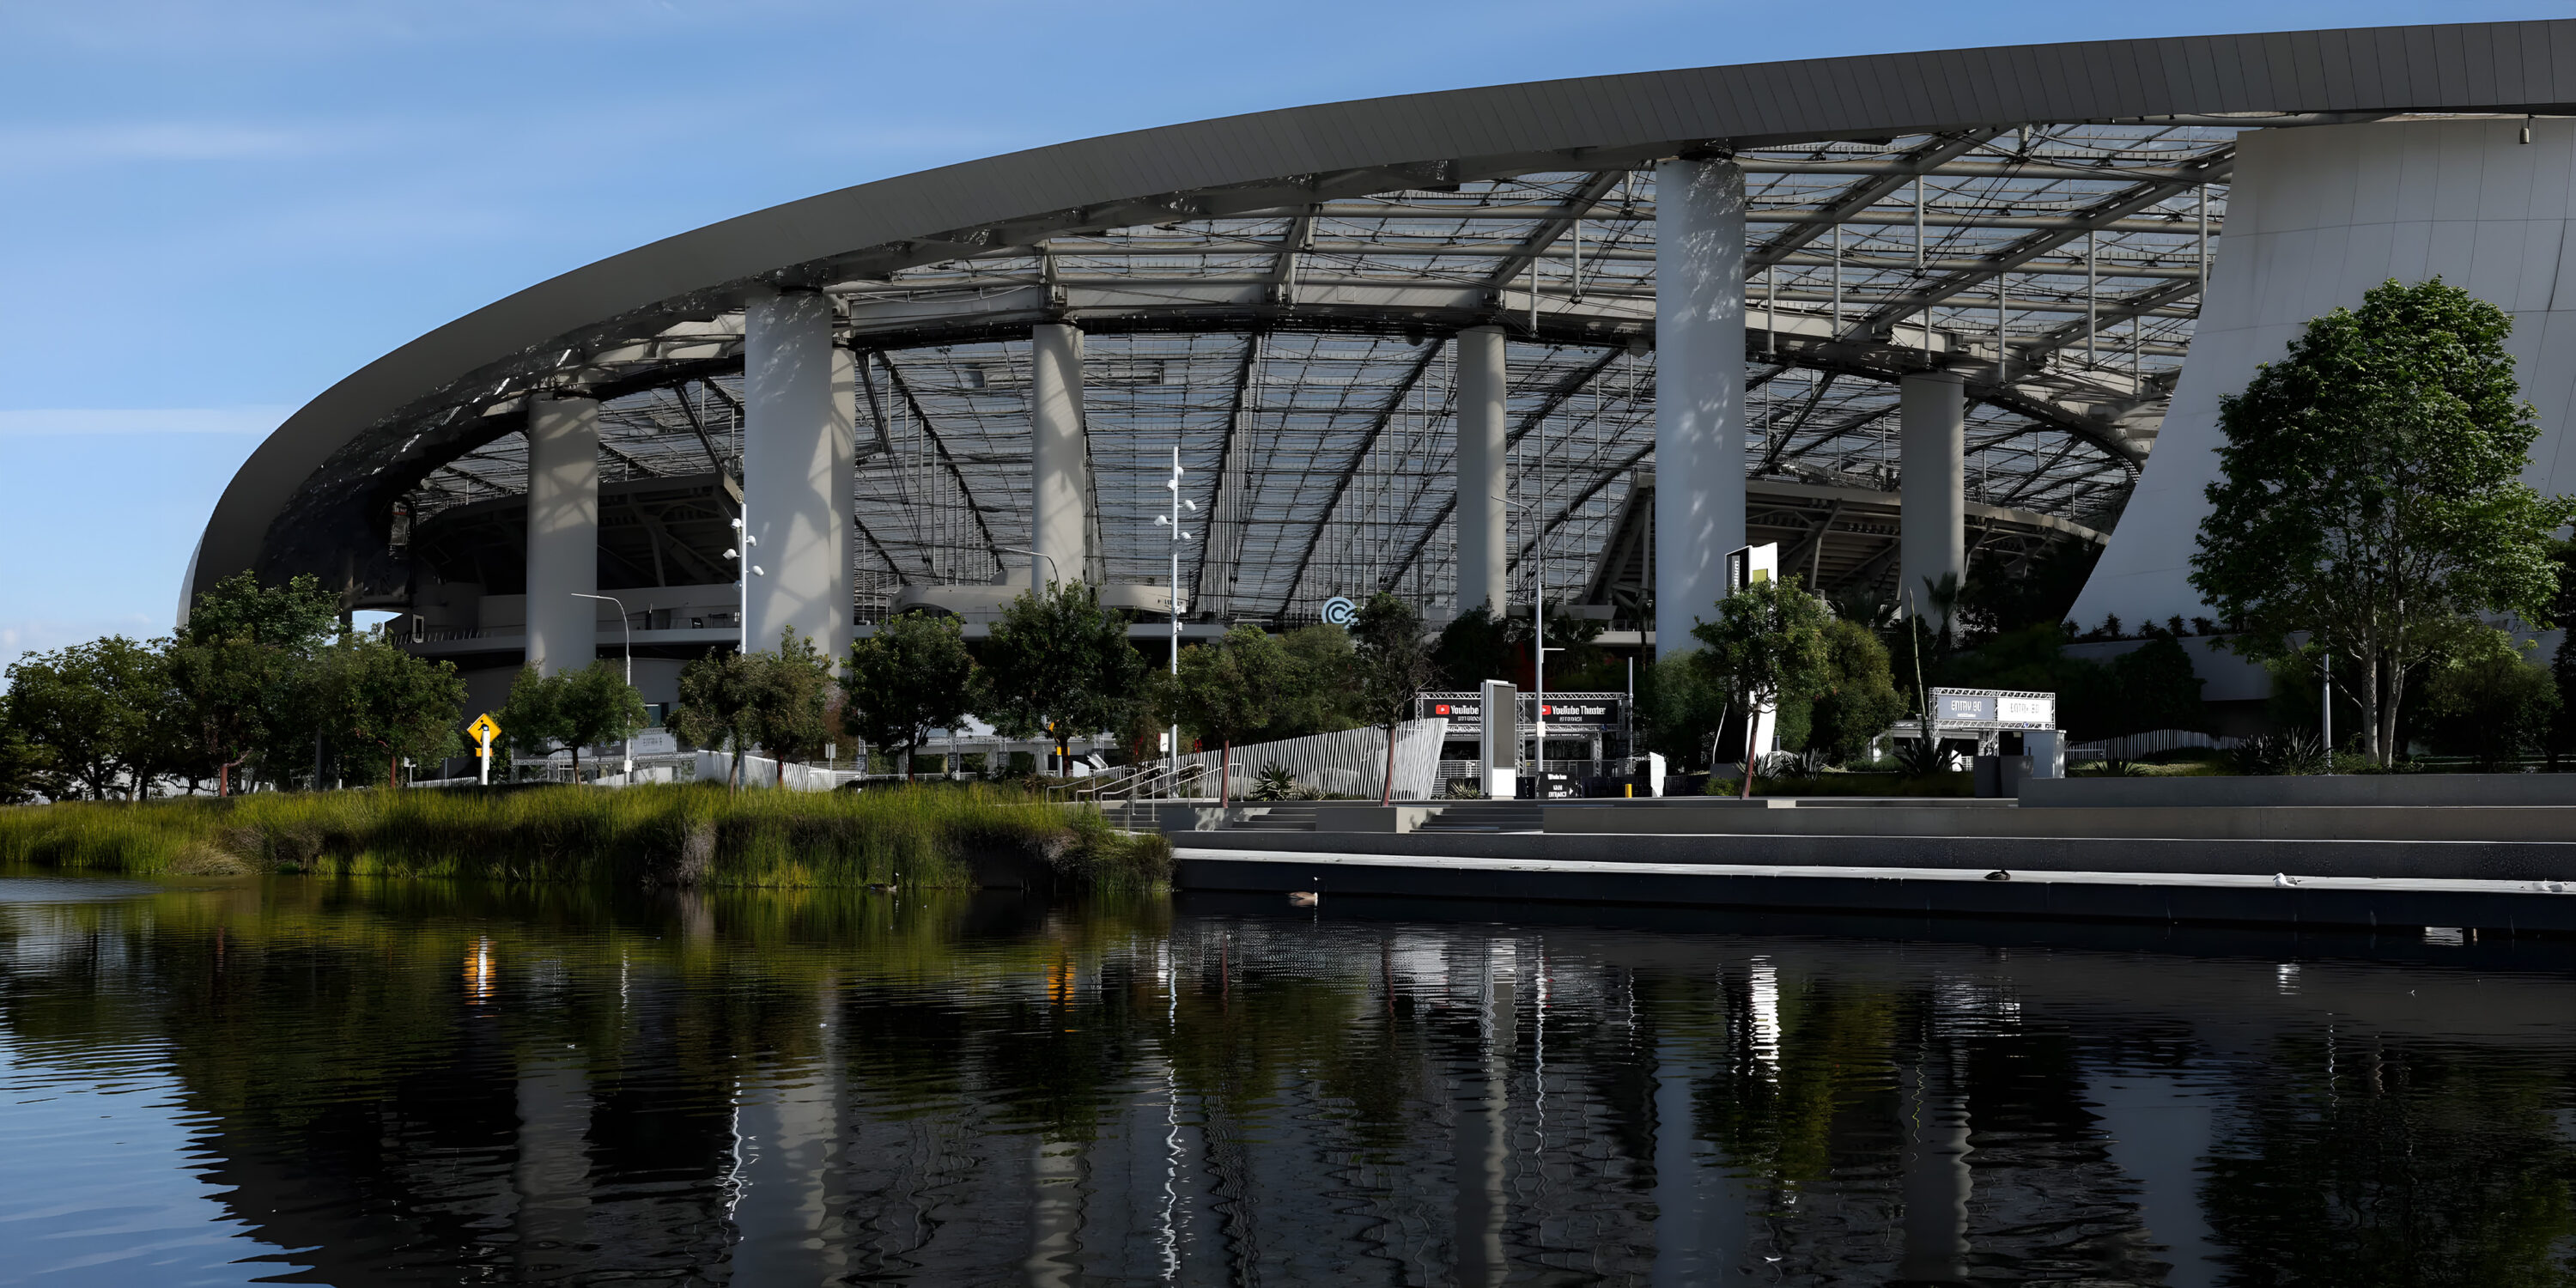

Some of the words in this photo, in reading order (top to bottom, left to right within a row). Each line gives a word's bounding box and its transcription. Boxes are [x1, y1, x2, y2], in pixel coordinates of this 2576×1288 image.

[1450, 704, 1479, 715] YouTube
[1552, 705, 1580, 715] YouTube
[1580, 705, 1606, 715] Theater
